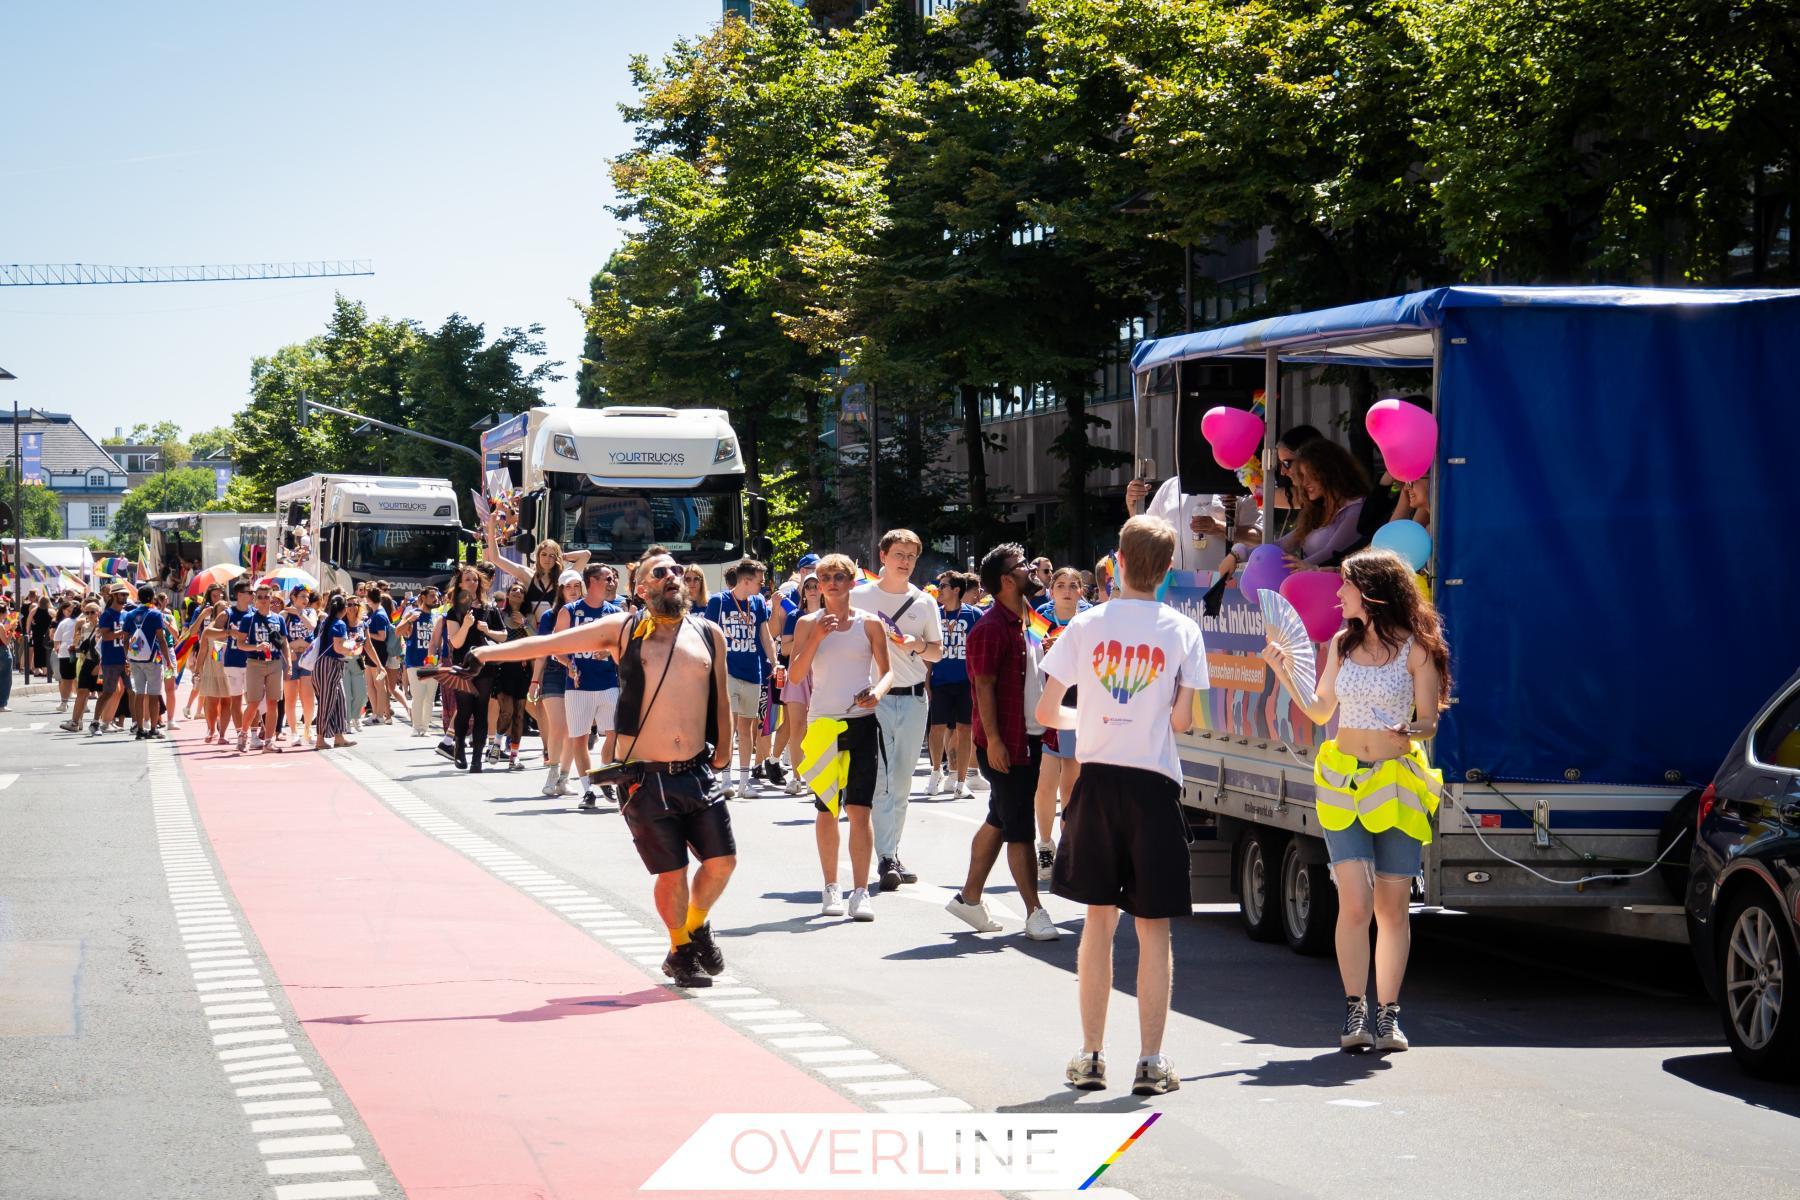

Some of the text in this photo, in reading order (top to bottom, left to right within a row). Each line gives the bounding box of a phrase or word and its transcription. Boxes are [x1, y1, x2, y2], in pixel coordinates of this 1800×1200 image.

[608, 452, 685, 463] YOURTRUCKS
[378, 502, 427, 511] YOURTRUCKS
[387, 582, 422, 590] CANIA
[941, 618, 968, 632] EAD
